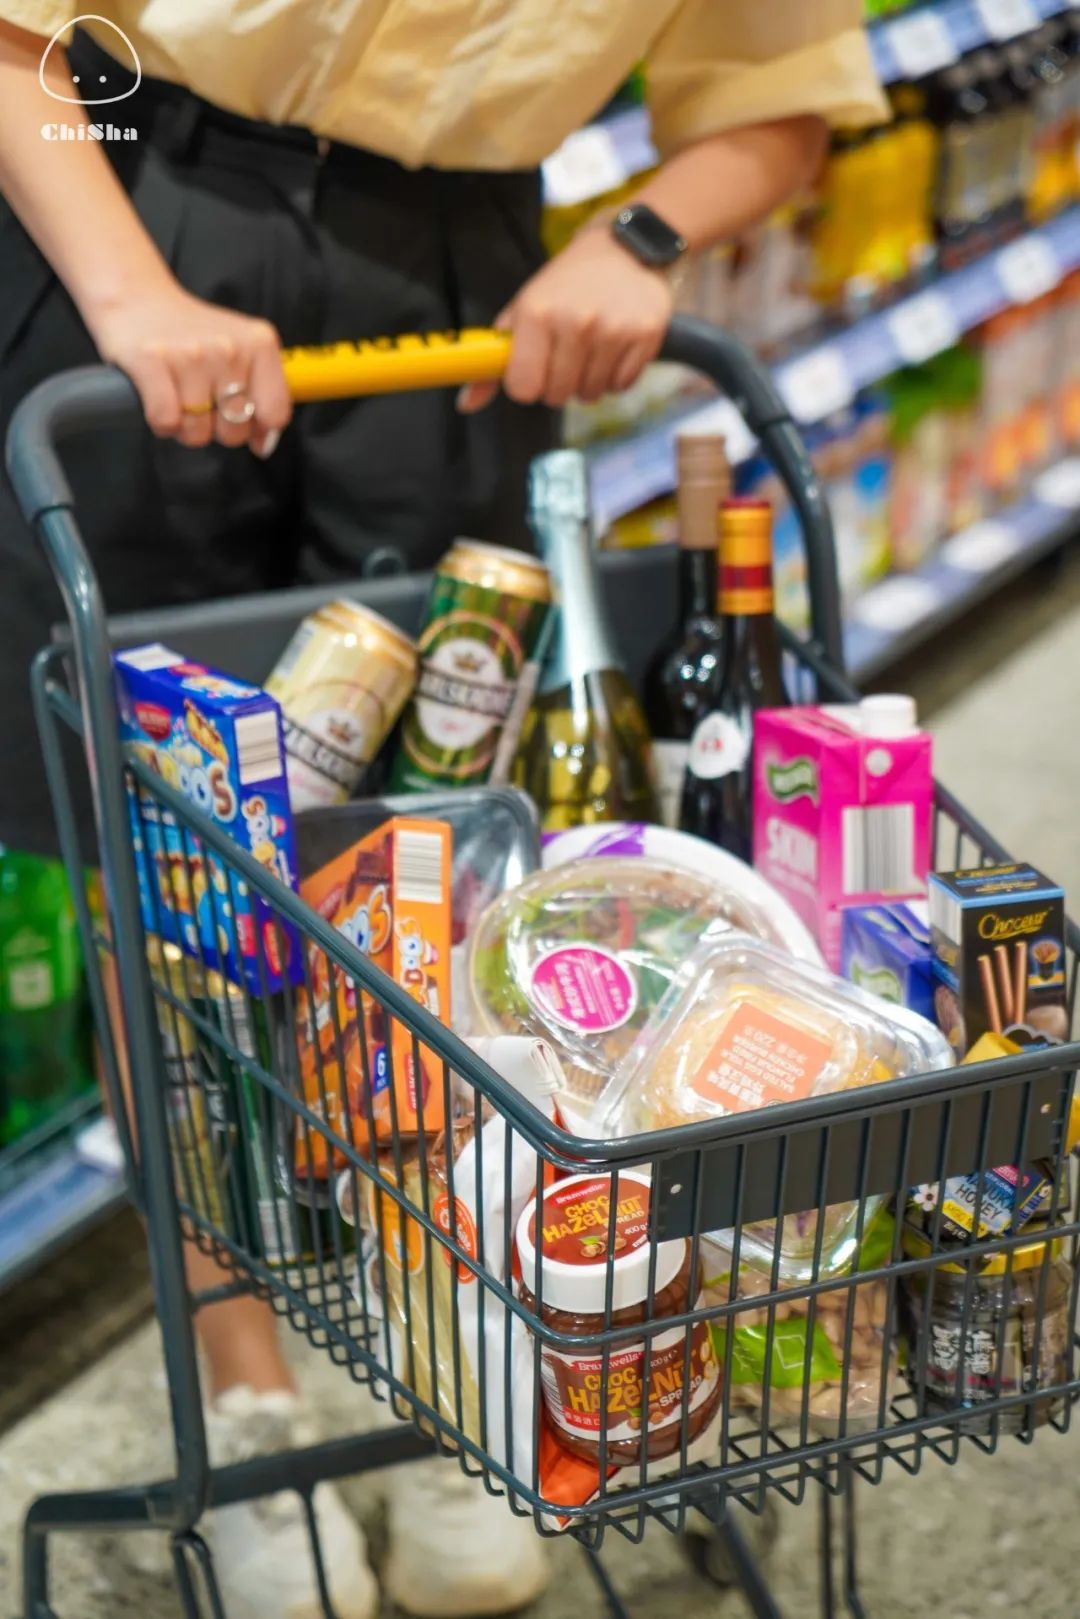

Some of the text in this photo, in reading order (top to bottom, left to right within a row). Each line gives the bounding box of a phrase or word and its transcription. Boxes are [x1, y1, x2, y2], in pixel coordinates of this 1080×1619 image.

[565, 1195, 609, 1219] CHOC
[584, 1367, 637, 1391] COC
[660, 1375, 703, 1407] SPRAD
